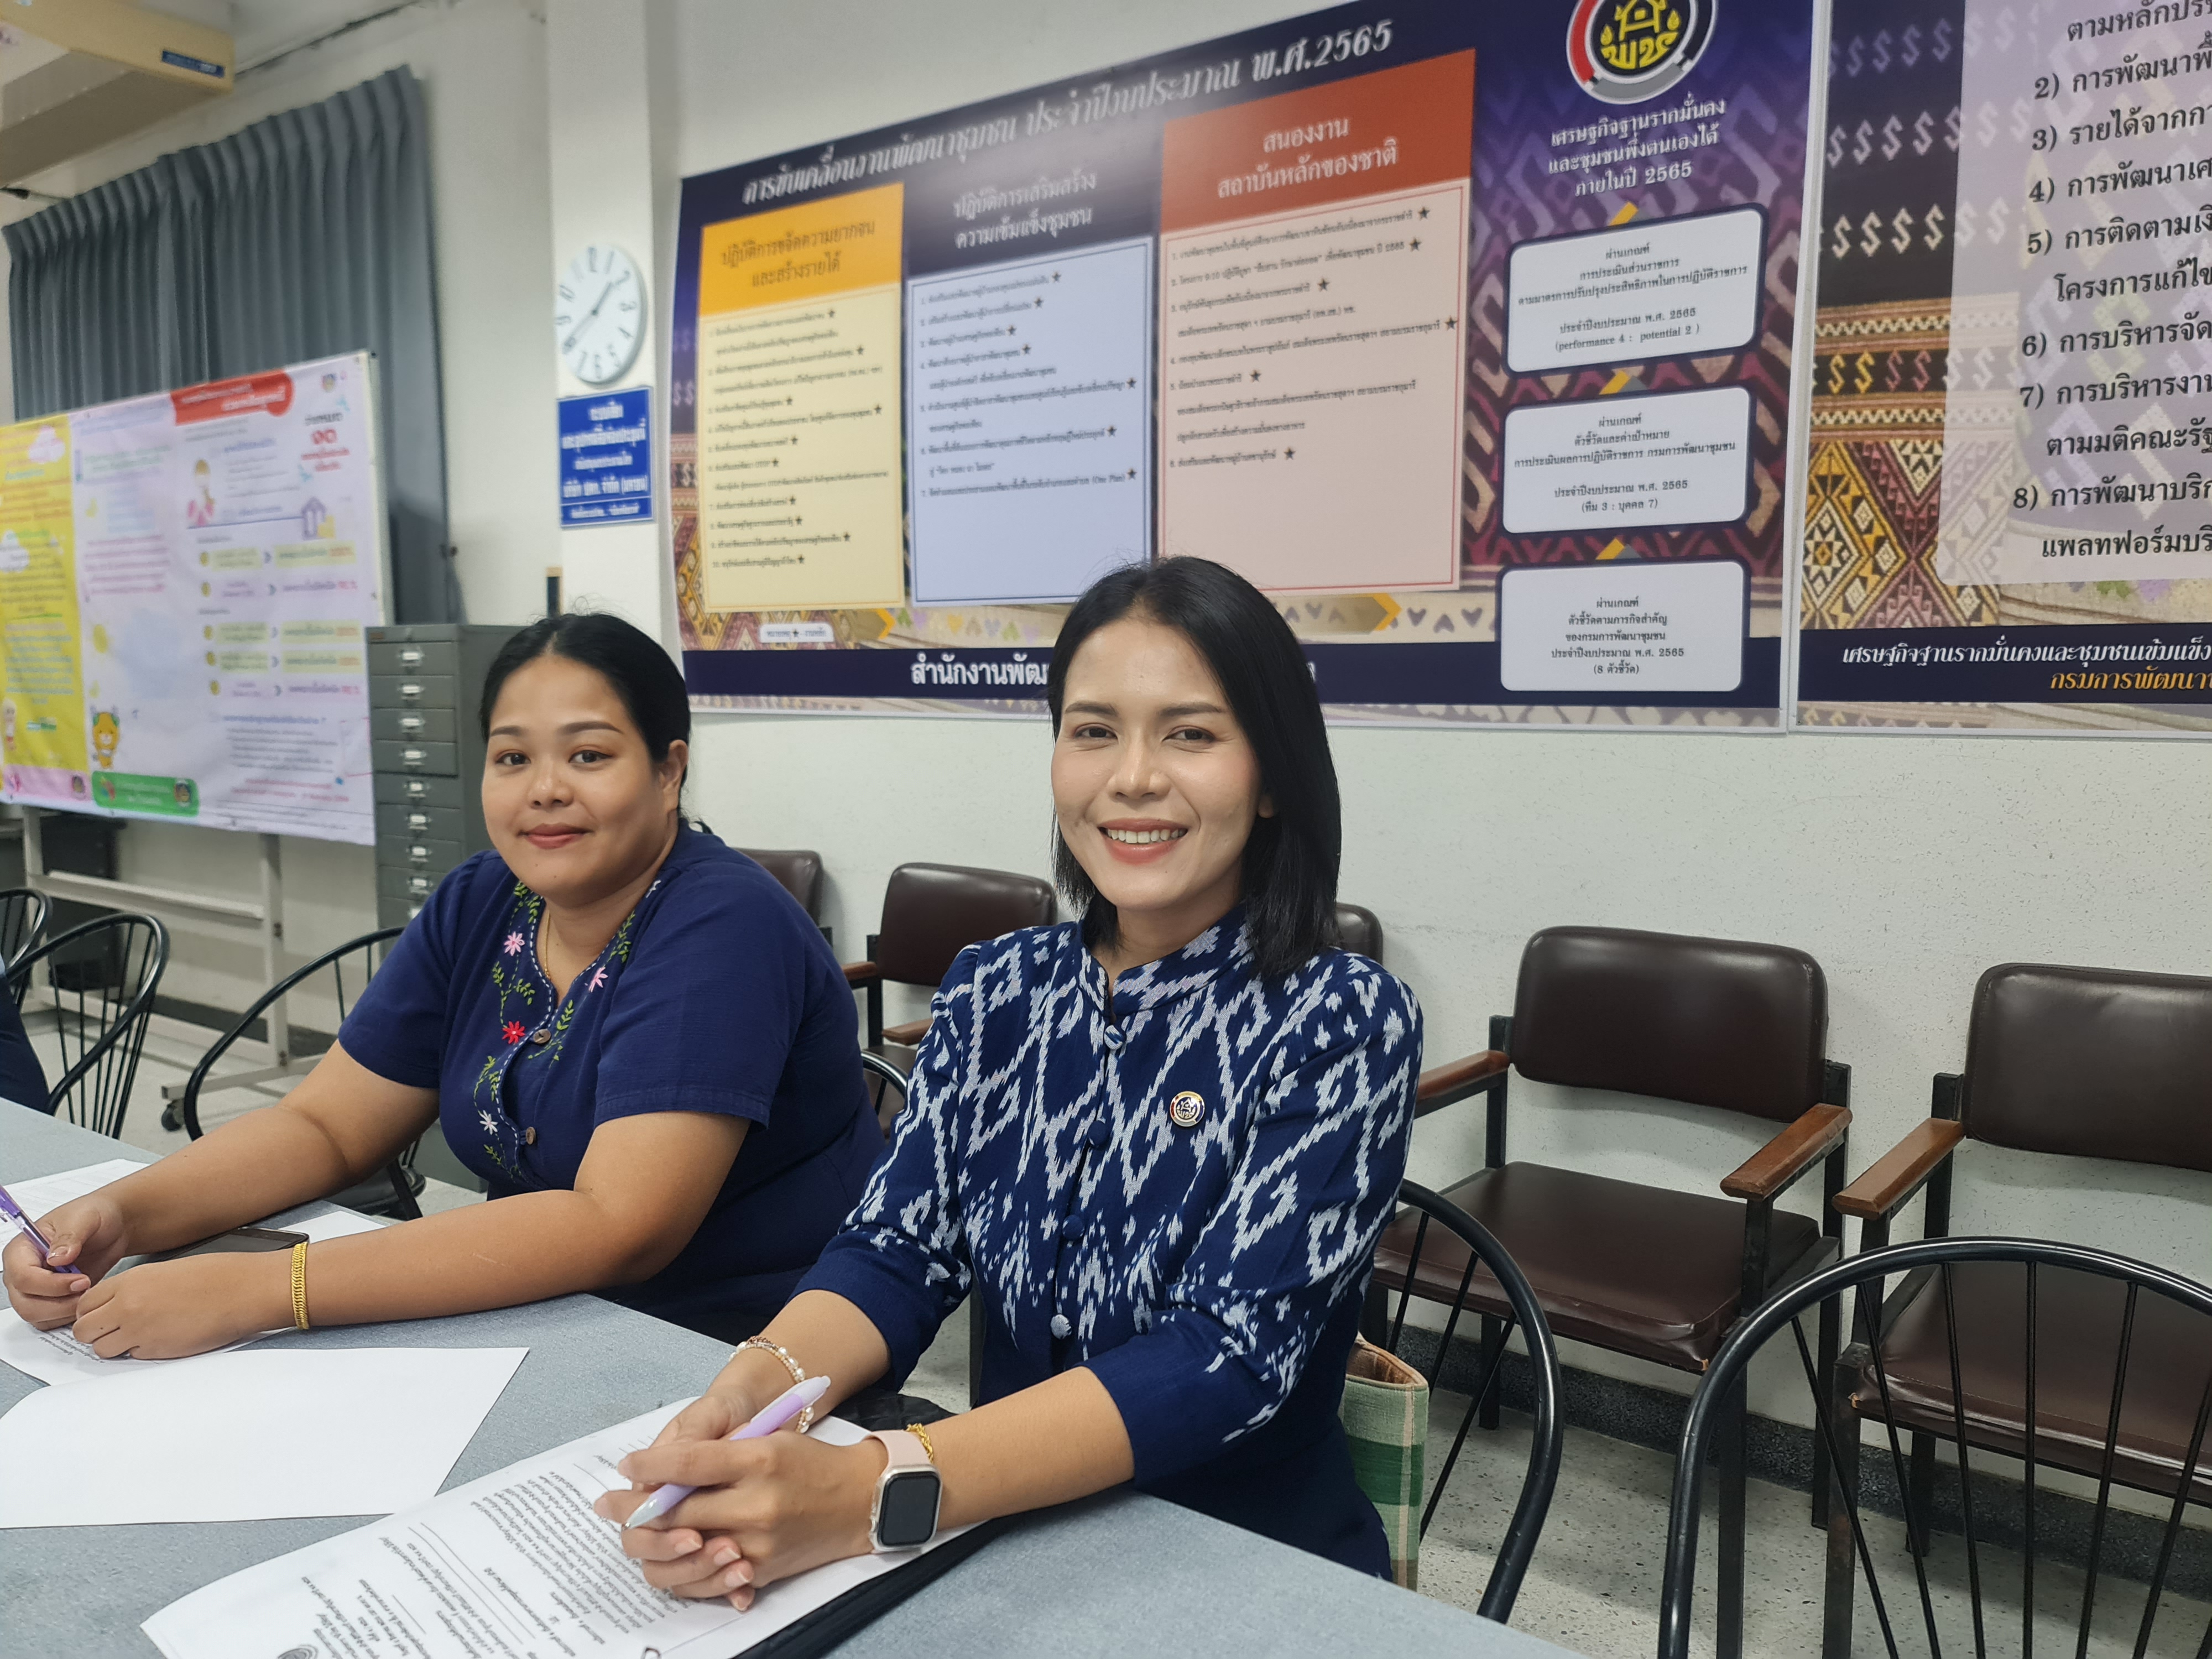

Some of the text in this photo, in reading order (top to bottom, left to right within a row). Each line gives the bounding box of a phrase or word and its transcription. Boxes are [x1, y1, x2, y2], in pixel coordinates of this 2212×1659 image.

[1251, 19, 1394, 82] พ.ศ.2565
[2034, 72, 2060, 100] 2)
[1551, 91, 1726, 146] เศรษฐกิจฐานรากมั่นคง
[2032, 105, 2212, 152] 3) รายได้จากก
[1263, 118, 1348, 153] สนองงาน
[1549, 122, 1719, 174] และชุมชนพึ่งตนเองได้
[1218, 138, 1397, 198] สถาบันหลักของชาติ
[1575, 161, 1692, 197] ภายในปี 2565
[2028, 177, 2054, 204] 4)
[1605, 242, 1650, 259] ผ่านเกณฑ์
[2027, 229, 2052, 256] 5)
[1580, 258, 1679, 281] การประเมินส่วนราชการ
[1559, 315, 1641, 335] ประจำปีงบประมาณ
[1670, 307, 1696, 320] 2565
[1554, 336, 1615, 353] (performance
[1619, 333, 1625, 343] 4
[1640, 327, 1681, 343] potential
[1685, 326, 1691, 335] 2
[2021, 332, 2047, 358] 6)
[2020, 384, 2044, 410] 7)
[1599, 413, 1642, 428] ผ่านเกณฑ์
[1574, 429, 1670, 447] ตัวชี้วัดและค่าเป้าหมาย
[1514, 441, 1736, 468] การประเมินผลการปฏิบัติราชการ กรมการพัฒนาชุมชน
[1554, 480, 1688, 498] ประจำปีงบประมาณ พ.ศ. 2565
[2013, 485, 2039, 511] 8)
[1601, 502, 1608, 511] 3
[1619, 500, 1644, 514] บุคคล
[1648, 498, 1658, 510] 7)
[1596, 596, 1639, 608] ผ่านเกณฑ์
[1568, 611, 1667, 627] ตัวชี้วัดตามภารกิจสำคัญ
[1566, 629, 1666, 644] ของกรมการพัฒนาชุมชน
[1551, 646, 1684, 659] ประจำปีงบประมาณ พ.ศ. 2565
[911, 651, 1050, 685] สำนักงานพัฒ
[1593, 660, 1640, 675] (8 ตัวชี้วัด)
